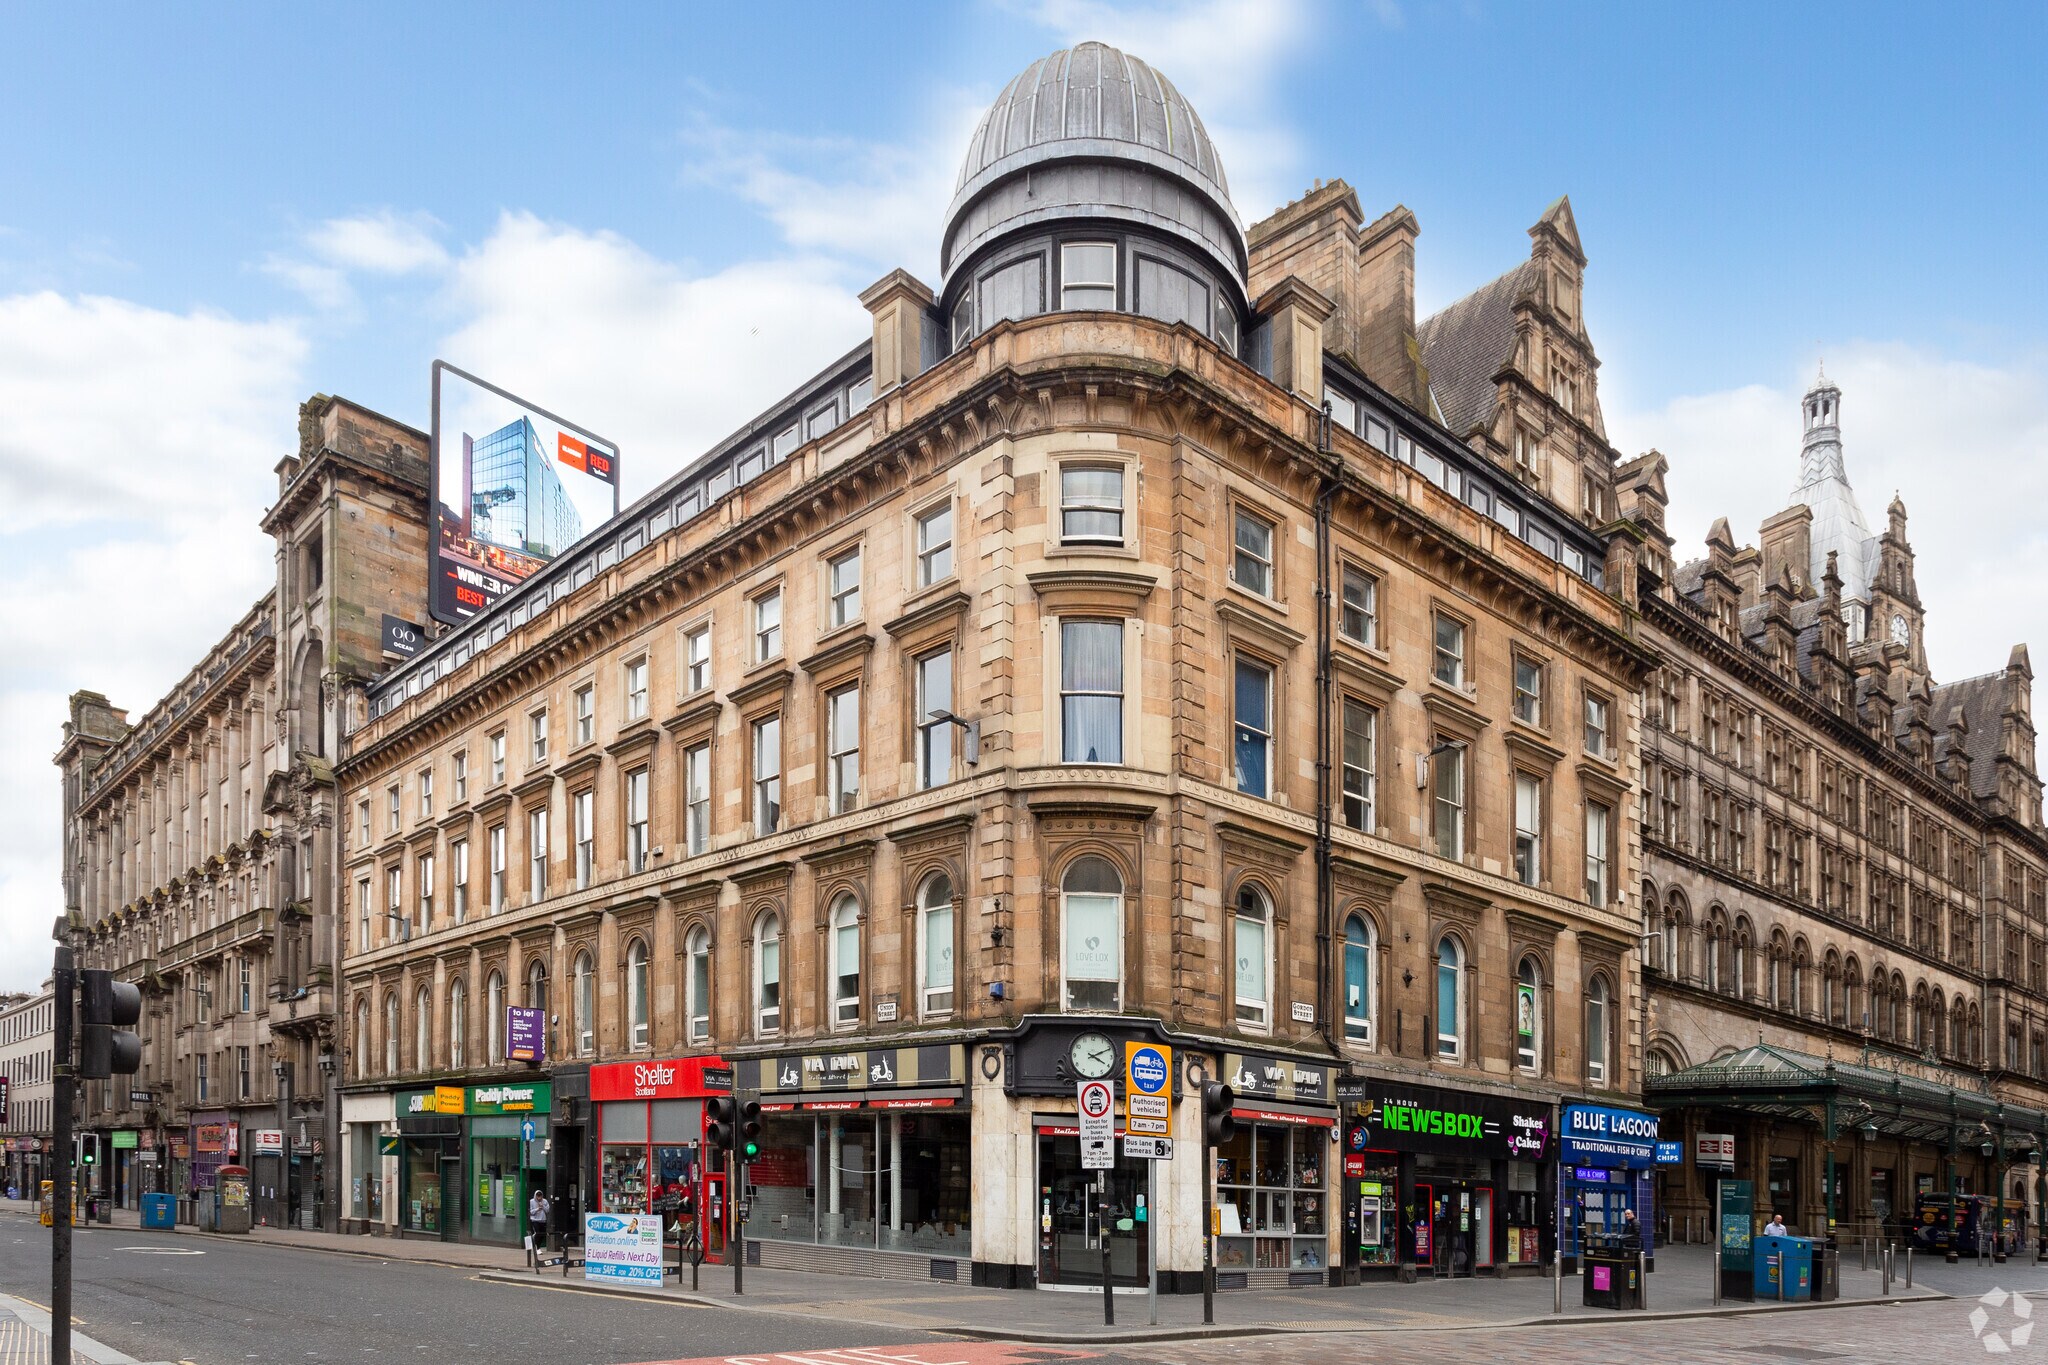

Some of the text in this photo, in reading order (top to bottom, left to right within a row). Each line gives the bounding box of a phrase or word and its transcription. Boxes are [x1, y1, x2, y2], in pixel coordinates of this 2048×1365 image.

[590, 453, 609, 472] RED
[456, 586, 485, 608] BEST
[1075, 952, 1109, 962] LOVE LOX
[512, 1009, 535, 1018] to let
[804, 1058, 826, 1072] VIA
[635, 1064, 675, 1087] Shelter
[1264, 1066, 1287, 1080] VIA
[131, 1092, 149, 1100] HOTEL
[475, 1086, 534, 1105] Paddy Power
[635, 1087, 656, 1096] Scotland
[920, 1100, 933, 1108] food
[1132, 1097, 1165, 1107] Authorised
[1396, 1099, 1418, 1108] HOUR
[1136, 1106, 1162, 1114] vehicles
[1260, 1112, 1279, 1121] italian
[1296, 1115, 1308, 1123] food
[1383, 1104, 1484, 1139] NEWSBOX
[1512, 1115, 1544, 1129] Shakes
[1573, 1110, 1658, 1138] BLUE LAGOON
[1054, 1127, 1079, 1136] italian
[1525, 1128, 1531, 1136] &
[1125, 1138, 1138, 1146] Bus
[1353, 1133, 1364, 1142] 24
[1515, 1136, 1541, 1149] Cakes
[1571, 1140, 1651, 1157] TRADITIONAL FISH & CHIPS
[1363, 1185, 1379, 1193] cash
[590, 1220, 619, 1231] STAY HOME
[587, 1234, 638, 1246] refillstation.online
[587, 1248, 660, 1265] E Liquid Refills Next Day
[602, 1264, 617, 1275] SAFE
[628, 1267, 645, 1277] 20%
[645, 1268, 660, 1278] OFF
